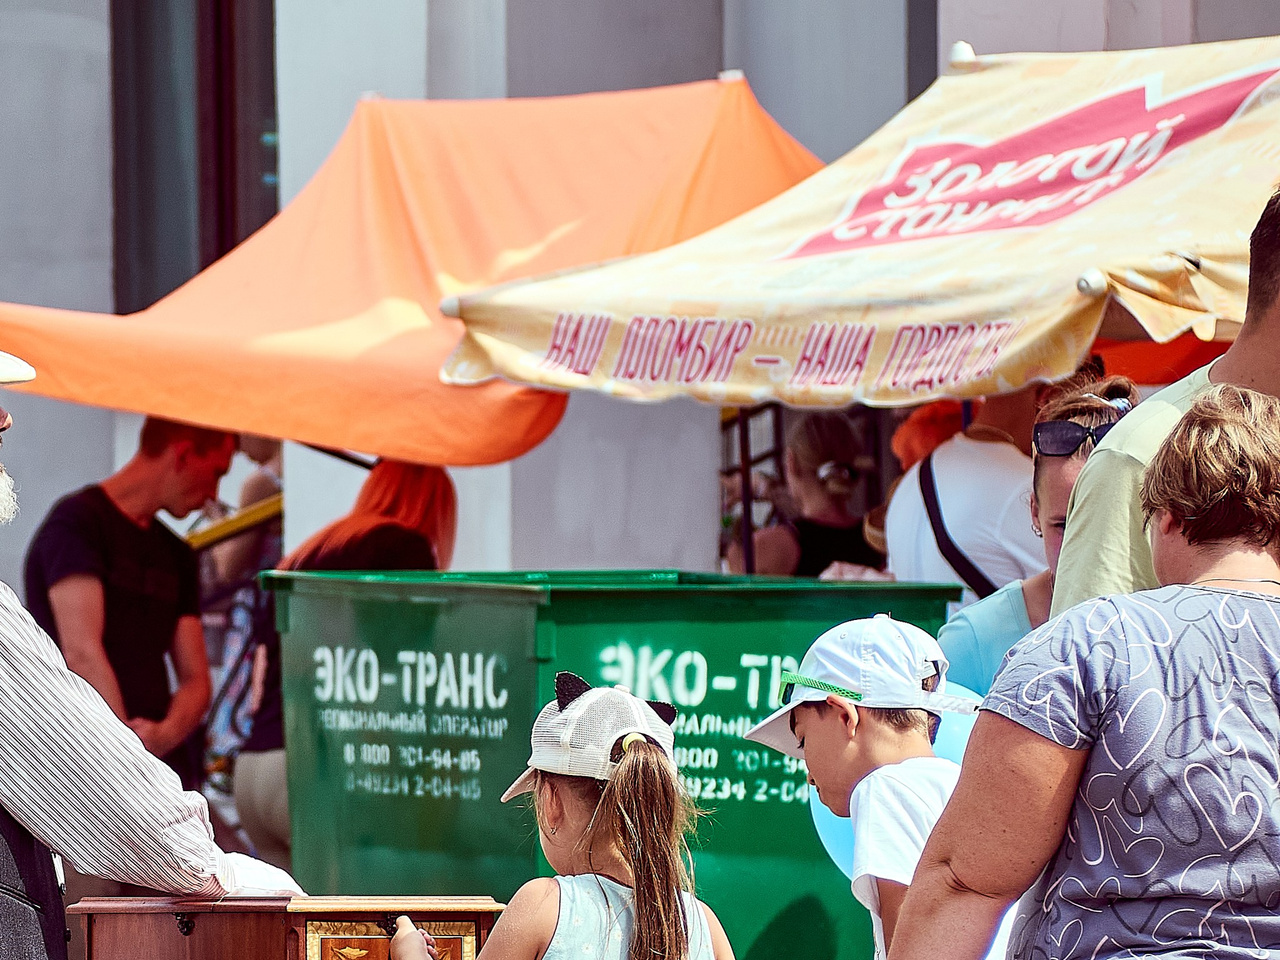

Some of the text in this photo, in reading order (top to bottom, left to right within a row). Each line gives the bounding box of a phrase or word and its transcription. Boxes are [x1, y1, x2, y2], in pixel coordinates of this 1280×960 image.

[539, 312, 613, 377] НАШ
[612, 315, 754, 384] ПЛОМБИР
[788, 321, 878, 387] НАША
[313, 645, 509, 710] ЭКО-ТРАНС
